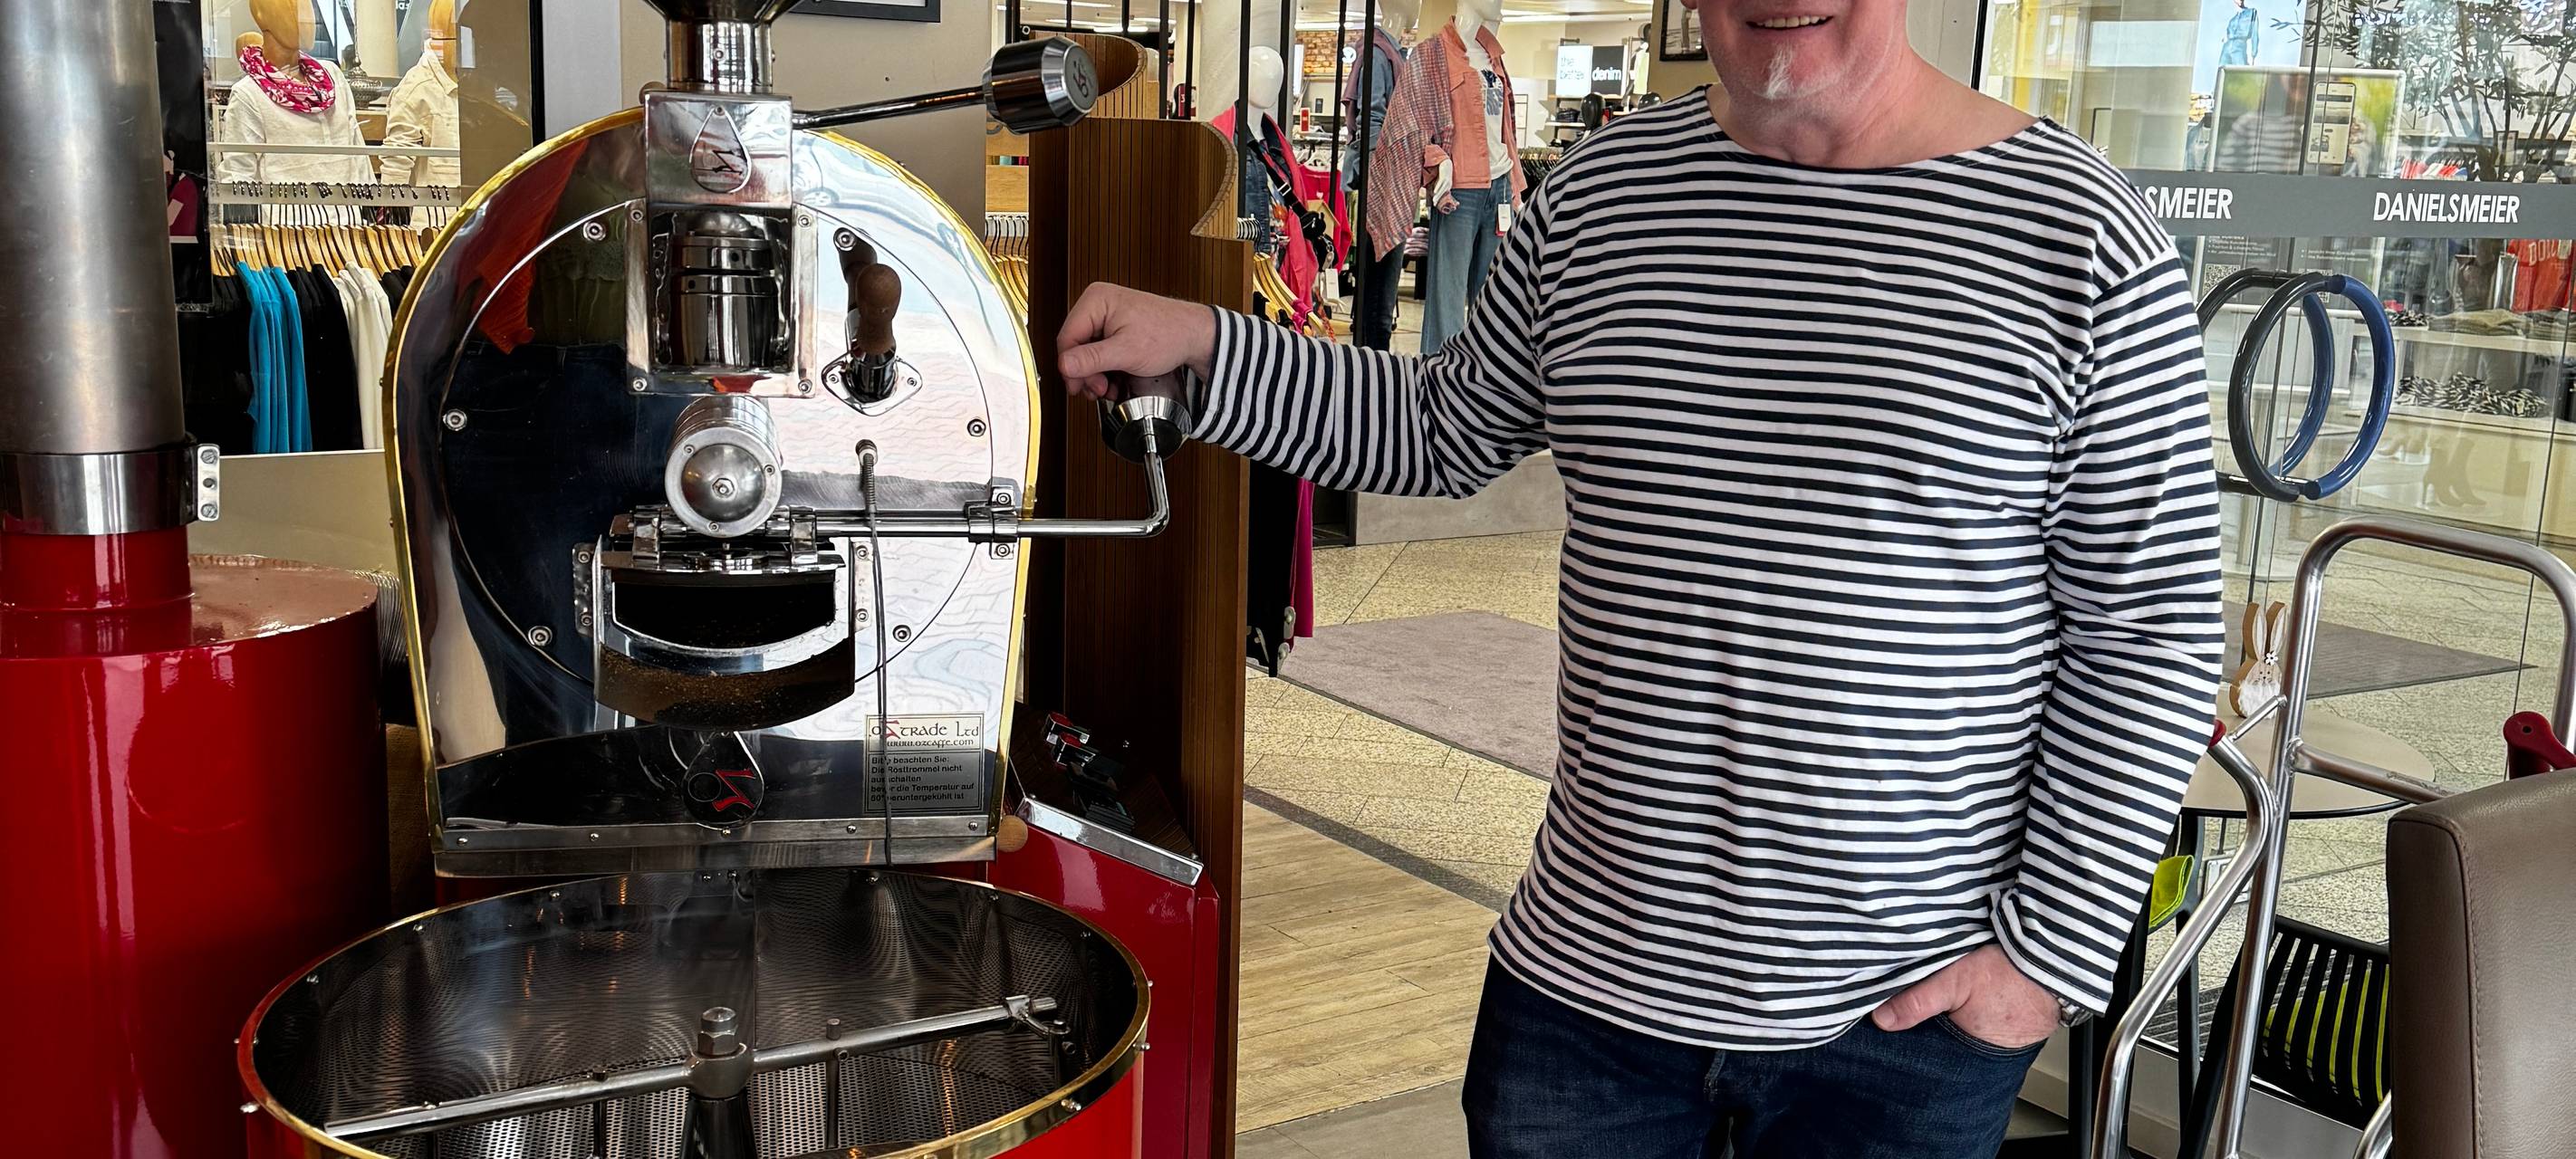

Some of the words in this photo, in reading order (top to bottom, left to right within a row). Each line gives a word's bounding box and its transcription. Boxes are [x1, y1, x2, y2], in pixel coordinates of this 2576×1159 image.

[1592, 66, 1621, 81] denim
[2135, 185, 2234, 219] SMEIER
[2373, 192, 2520, 223] DANIELSMEIER
[956, 721, 979, 737] Ltd
[893, 756, 932, 764] beachten
[871, 766, 885, 774] Die
[942, 764, 962, 772] nicht
[870, 785, 896, 793] bevr
[912, 782, 959, 792] Temperatur
[961, 782, 975, 790] auf
